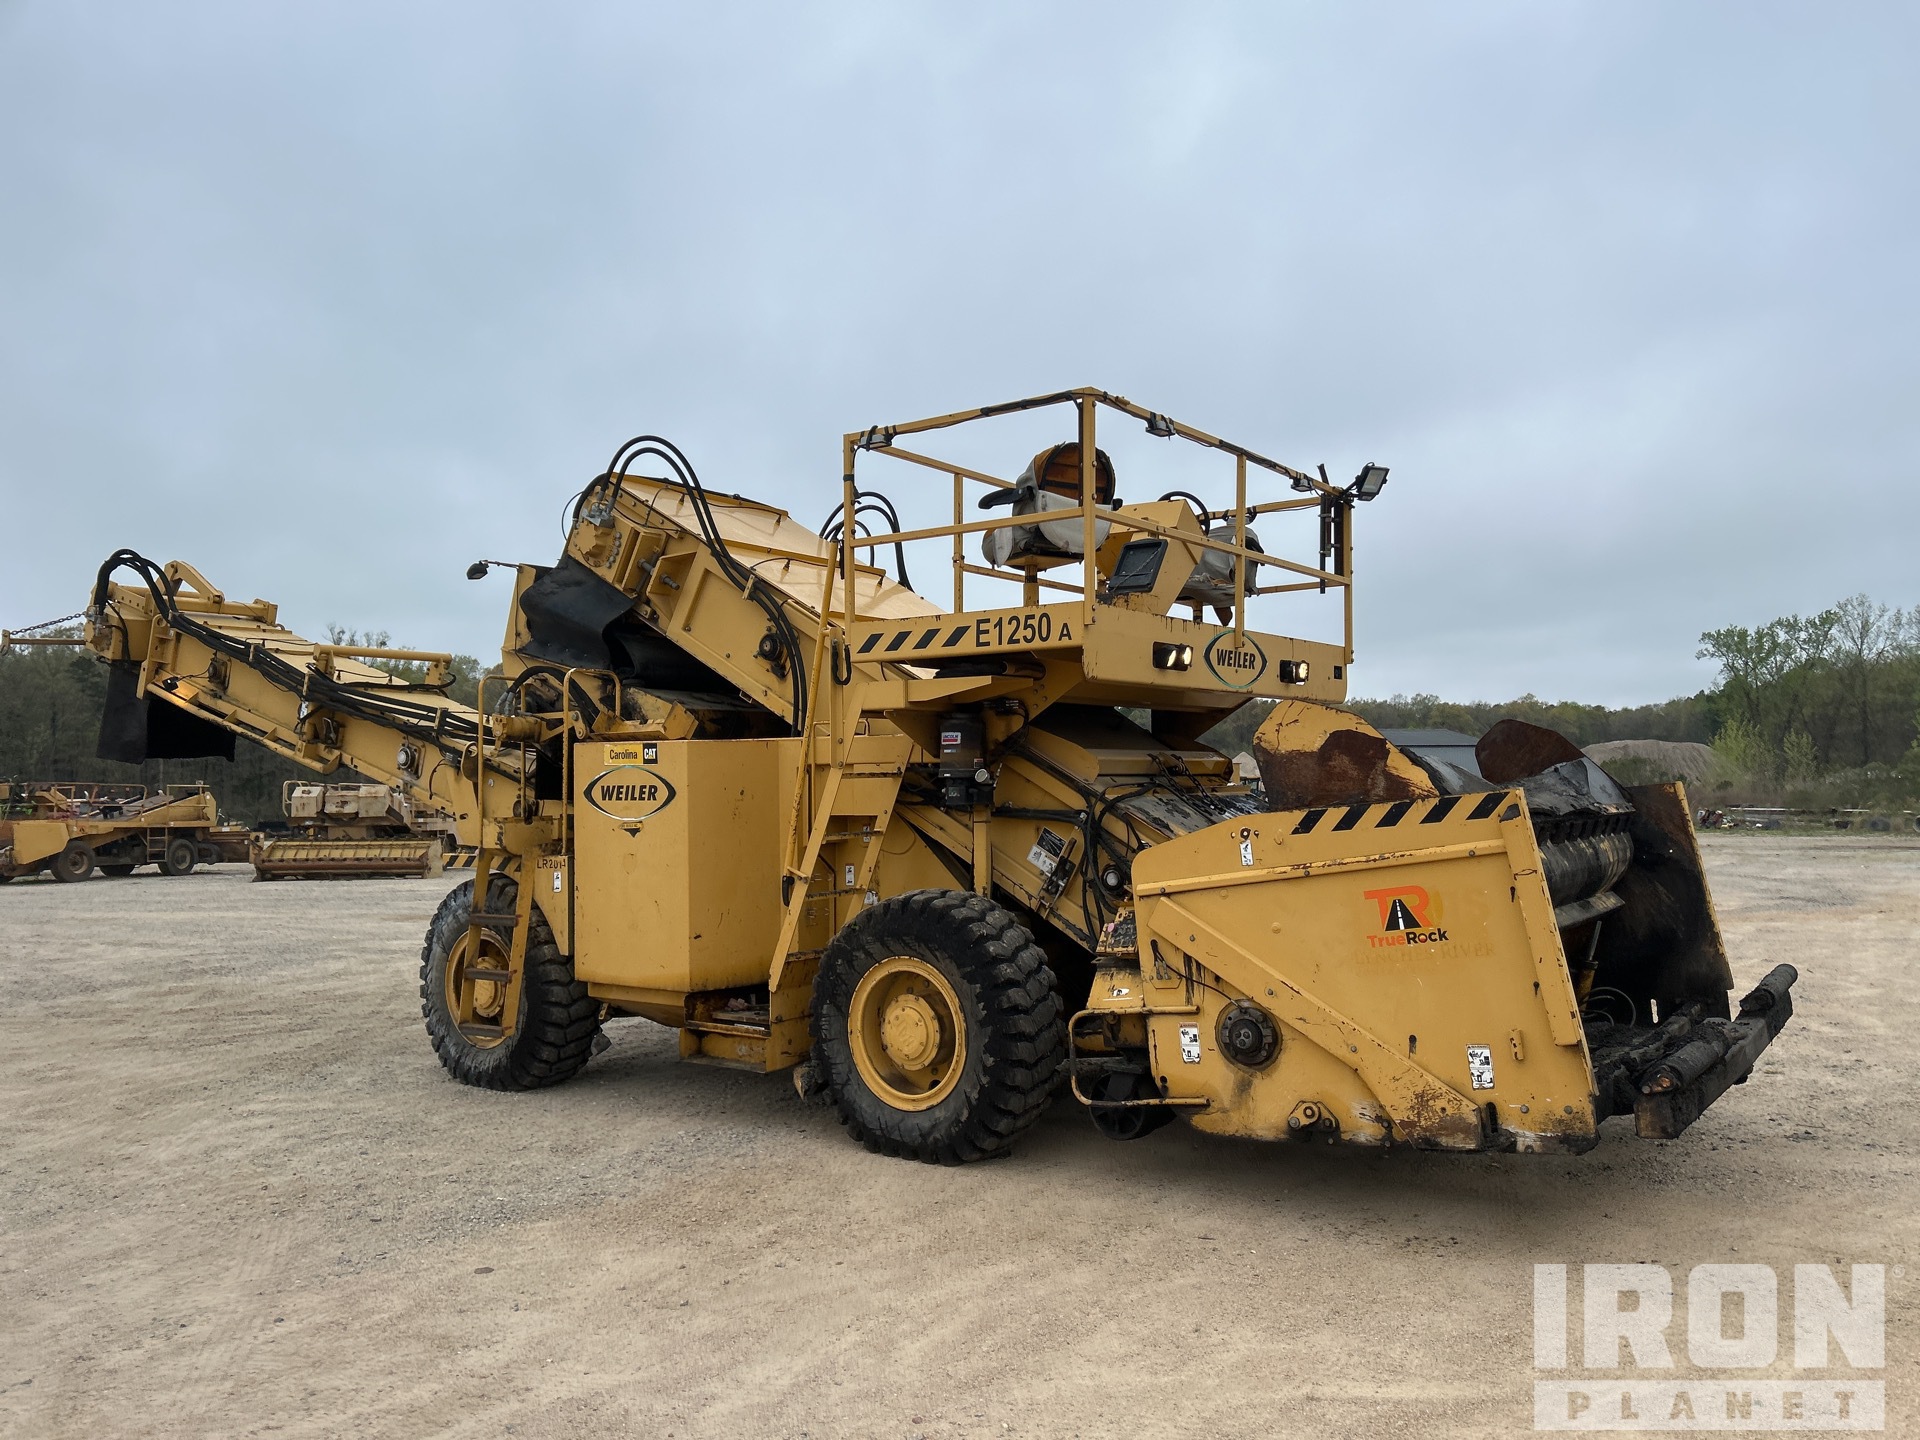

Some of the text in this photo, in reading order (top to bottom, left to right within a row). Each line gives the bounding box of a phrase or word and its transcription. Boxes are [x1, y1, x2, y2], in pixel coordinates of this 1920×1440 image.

[975, 611, 1072, 648] E1250 A
[1215, 648, 1256, 670] WEILER
[609, 749, 638, 760] Carolina
[643, 748, 656, 760] CAT
[600, 784, 658, 801] WEILER
[1366, 927, 1449, 948] TrueRock
